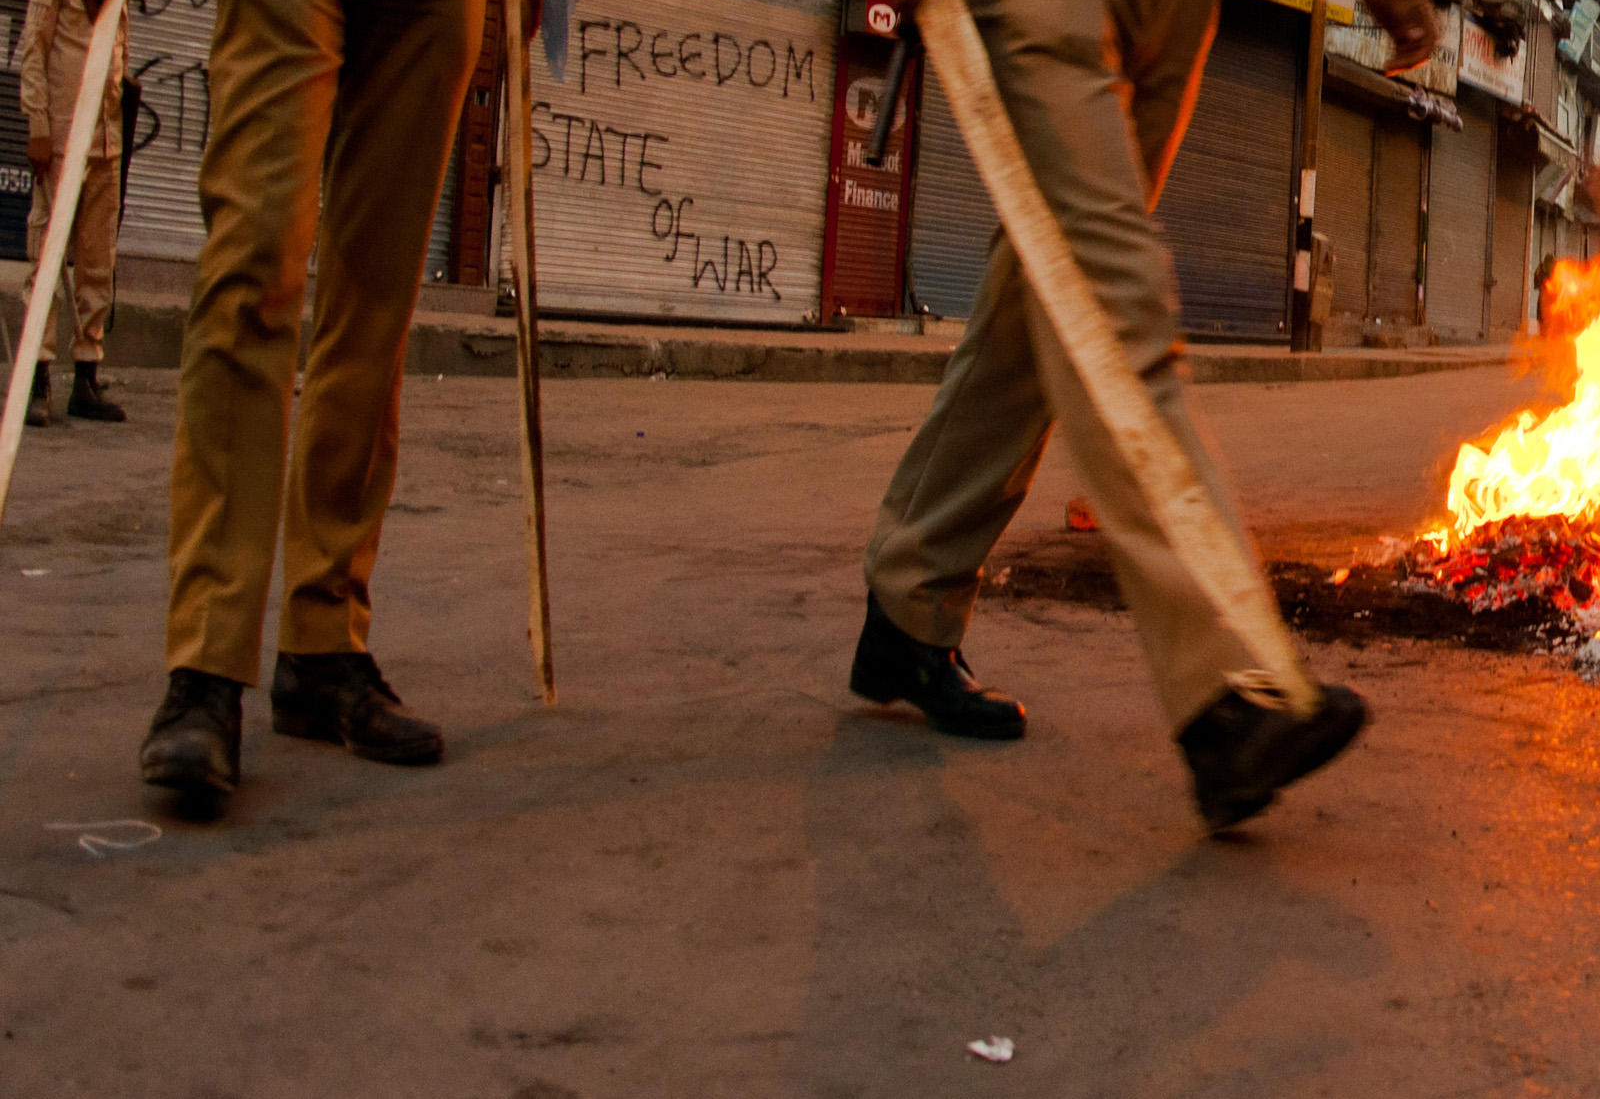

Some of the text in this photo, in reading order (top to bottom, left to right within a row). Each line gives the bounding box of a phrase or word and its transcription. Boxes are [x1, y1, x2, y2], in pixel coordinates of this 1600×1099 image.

[579, 19, 816, 102] FREEDOM
[531, 101, 669, 196] STATE
[844, 179, 899, 212] Finance
[692, 235, 782, 301] WAR
